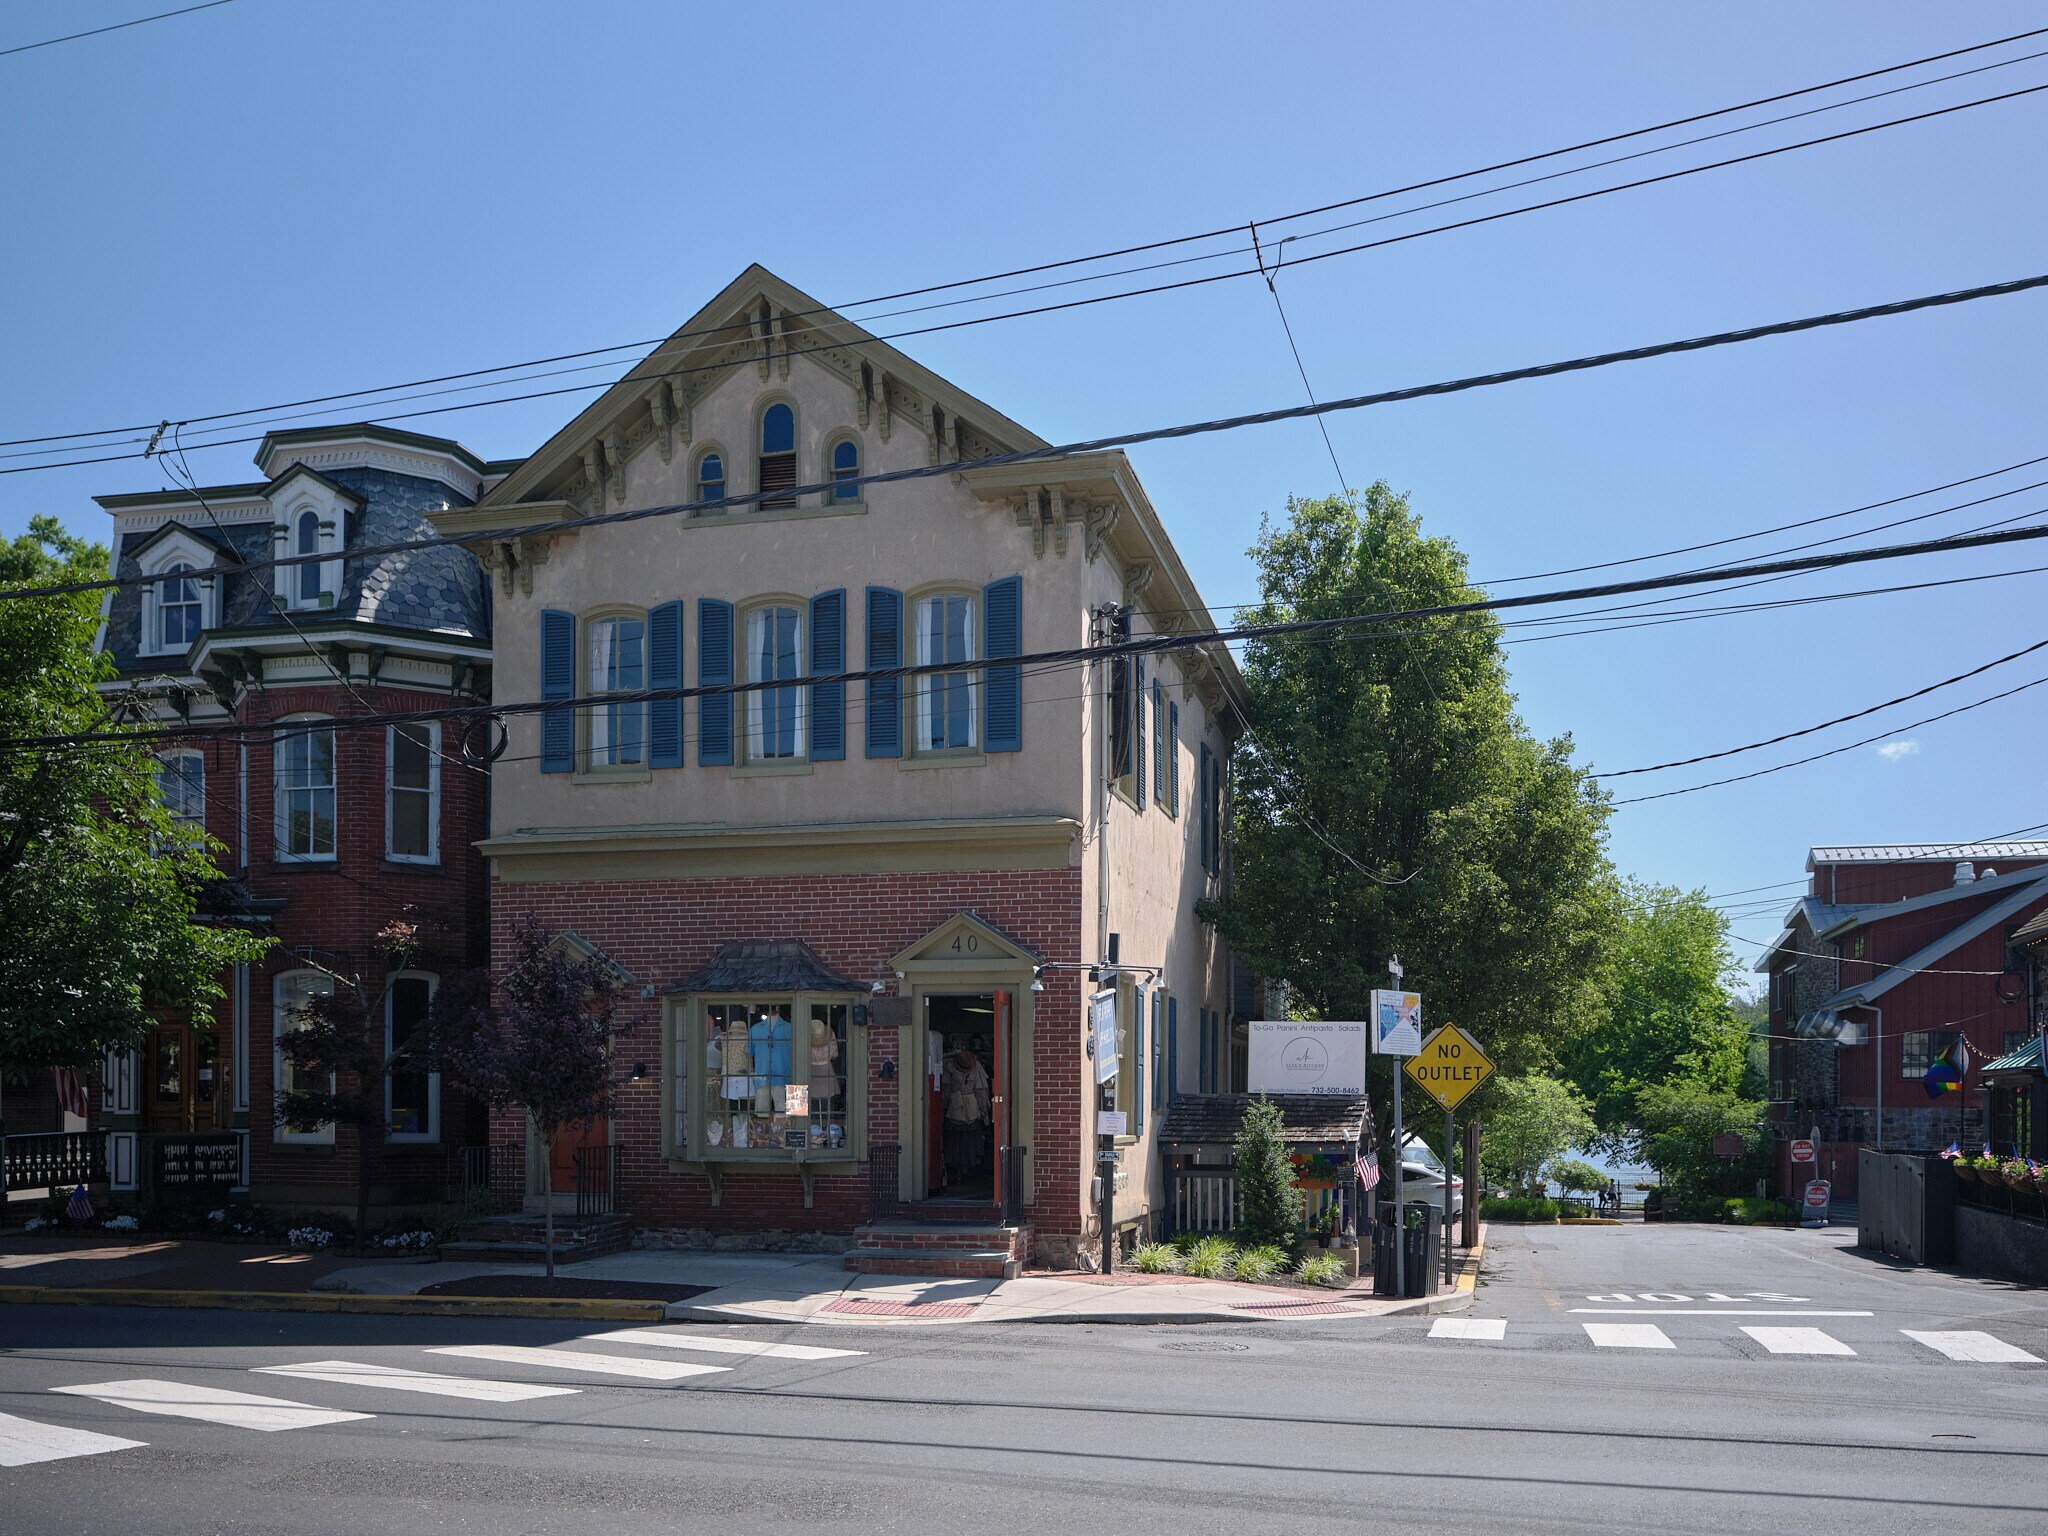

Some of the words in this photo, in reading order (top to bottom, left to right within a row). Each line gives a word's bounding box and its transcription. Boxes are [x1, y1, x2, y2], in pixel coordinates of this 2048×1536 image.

[952, 935, 977, 952] 40
[1253, 1024, 1274, 1032] To-Go
[1300, 1024, 1334, 1033] Antipasto
[1338, 1024, 1361, 1032] Salads
[1438, 1044, 1461, 1058] NO
[1417, 1066, 1483, 1081] OUTLET
[1311, 1086, 1360, 1094] 732-500-8462
[1586, 1292, 1812, 1303] STOP
